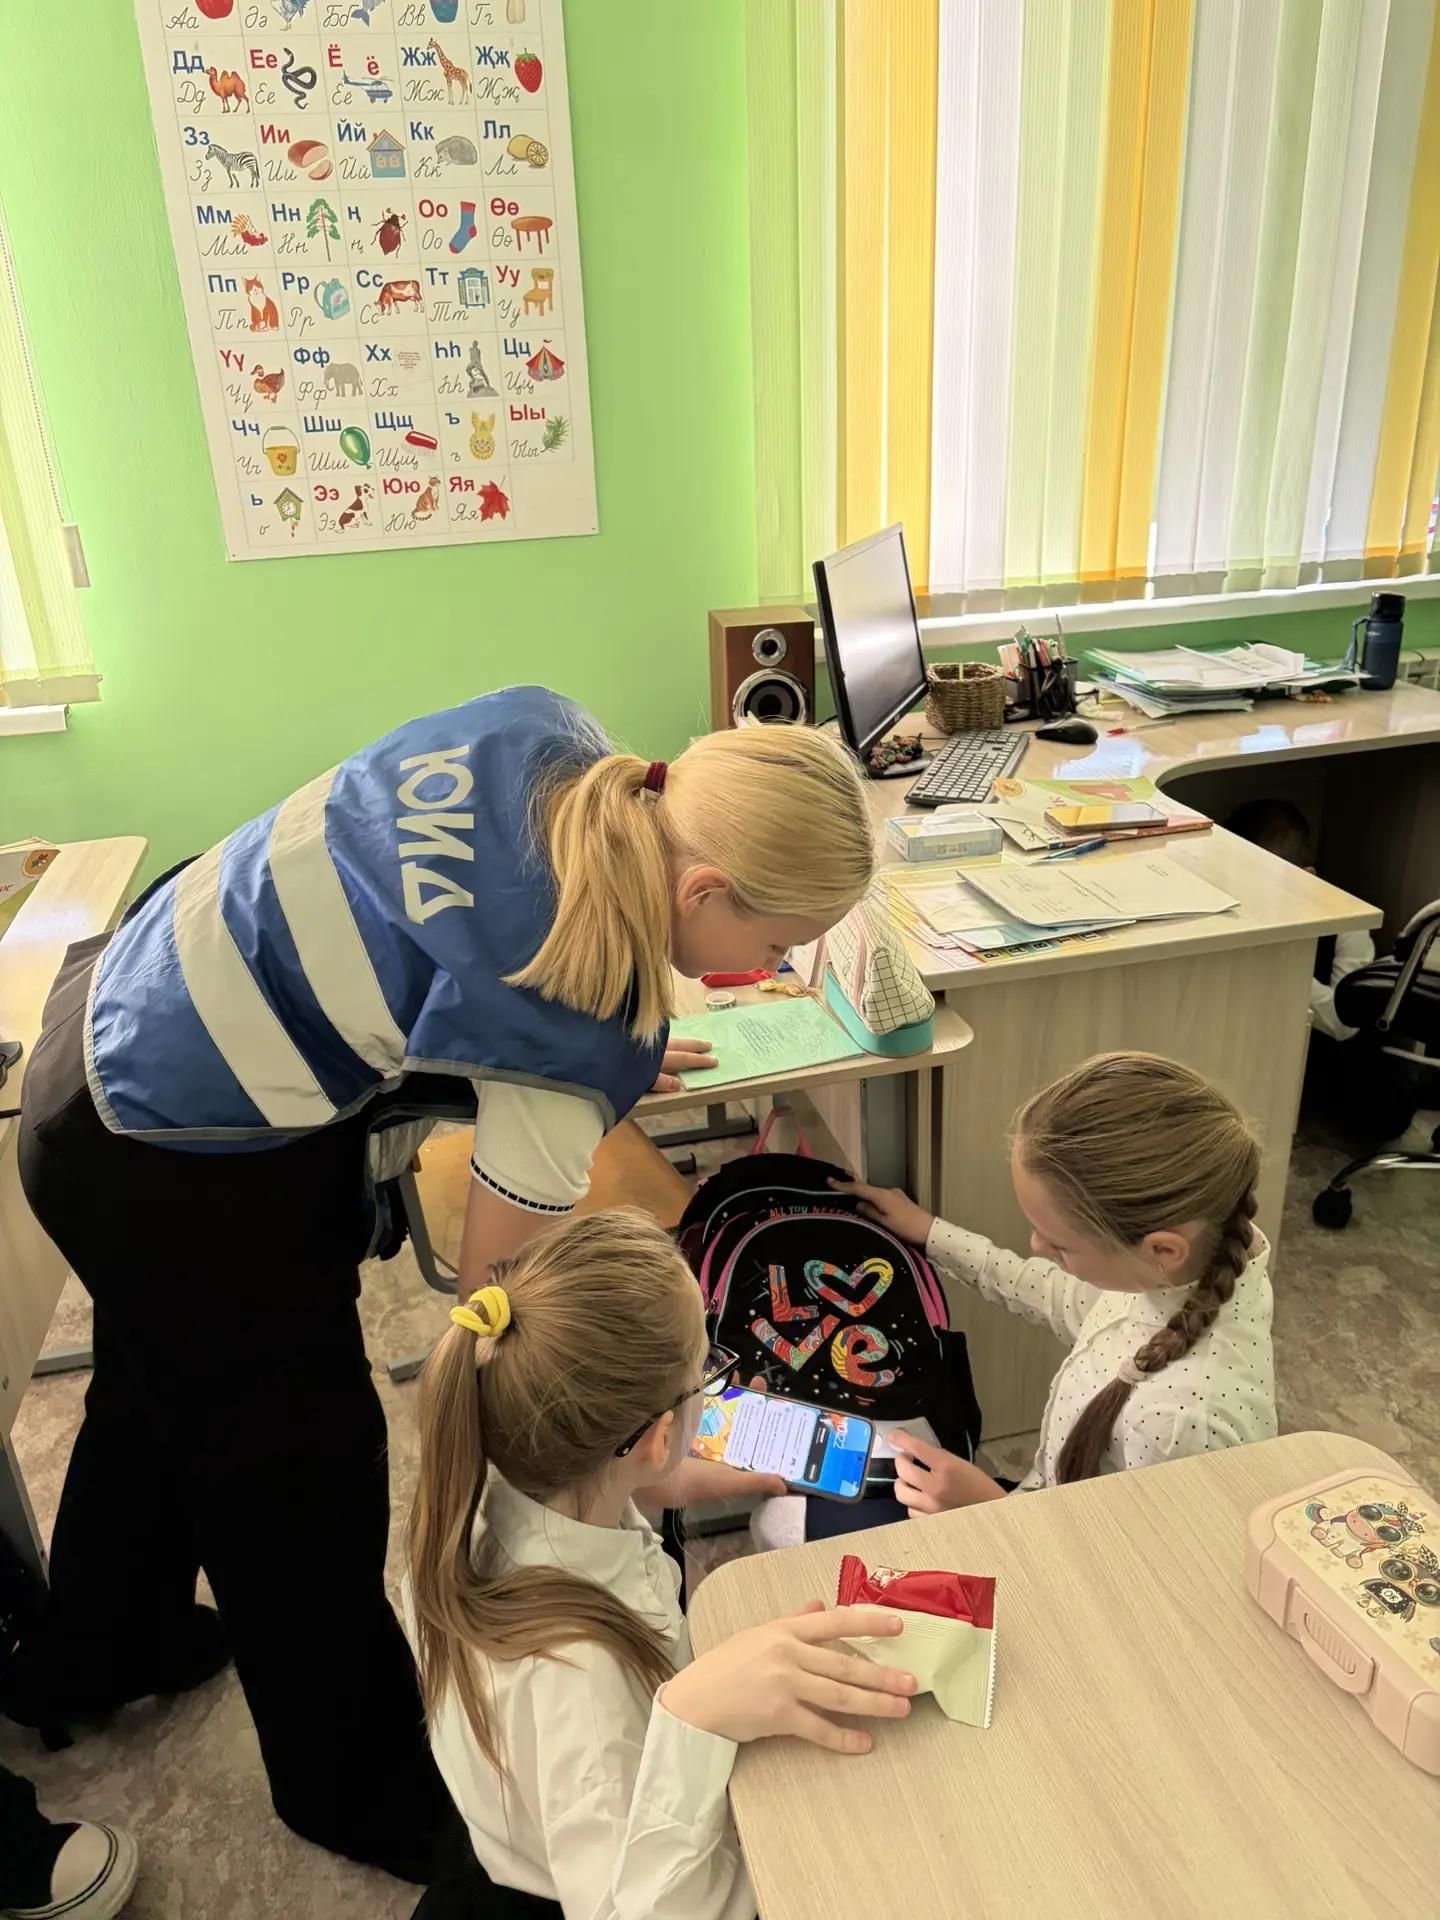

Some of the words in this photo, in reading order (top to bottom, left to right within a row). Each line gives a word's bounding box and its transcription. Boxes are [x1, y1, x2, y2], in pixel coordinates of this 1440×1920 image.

[166, 7, 199, 29] Аа
[323, 4, 359, 27] Бб
[398, 3, 425, 26] Вв
[471, 3, 494, 25] Гг
[173, 50, 205, 74] Дд
[250, 49, 278, 69] Ее
[328, 44, 343, 67] Ё
[366, 56, 380, 75] ё
[401, 47, 437, 66] Жж
[177, 81, 206, 113] Дд
[255, 82, 275, 104] Ее
[404, 80, 445, 101] Жж
[183, 126, 210, 145] Зз
[260, 125, 290, 143] Ии
[337, 118, 366, 142] Йй
[410, 121, 434, 140] Кк
[483, 120, 510, 139] Лл
[190, 159, 212, 191] Зз
[264, 159, 298, 181] Ии
[339, 156, 371, 179] Йй
[414, 156, 441, 178] Кк
[485, 155, 518, 176] Лл
[196, 205, 232, 224] Мм
[271, 203, 300, 222] Нн
[419, 199, 448, 218] Оо
[490, 198, 519, 215] Өө
[202, 236, 248, 256] Мм
[278, 233, 308, 254] Нн
[422, 229, 442, 250] Оо
[208, 275, 237, 293] Пп
[282, 272, 310, 294] Рр
[356, 270, 383, 287] Сс
[425, 268, 449, 286] Тт
[496, 265, 520, 287] Уу
[215, 308, 249, 330] Пп
[288, 307, 315, 336] Рр
[360, 304, 380, 324] Сс
[429, 301, 469, 321] Тт
[498, 299, 520, 328] Уу
[293, 346, 330, 368] Фф
[365, 344, 392, 361] Хх
[504, 338, 531, 358] Цц
[297, 381, 327, 410] Фф
[370, 378, 399, 397] Хх
[505, 371, 534, 395] Цц
[232, 419, 260, 436] Чч
[304, 415, 341, 433] Шш
[375, 411, 414, 431] Щщ
[510, 404, 545, 421] Ыы
[237, 456, 261, 475] Чч
[308, 452, 349, 472] Шш
[376, 448, 418, 471] Щщ
[510, 440, 540, 458] Ыы
[313, 485, 339, 501] Ээ
[383, 478, 420, 494] Юю
[449, 476, 474, 492] Яя
[319, 512, 336, 531] Ээ
[385, 513, 416, 532] Юю
[451, 502, 479, 522] Яя
[396, 744, 474, 925] ЮИД
[1383, 1589, 1400, 1601] OK
